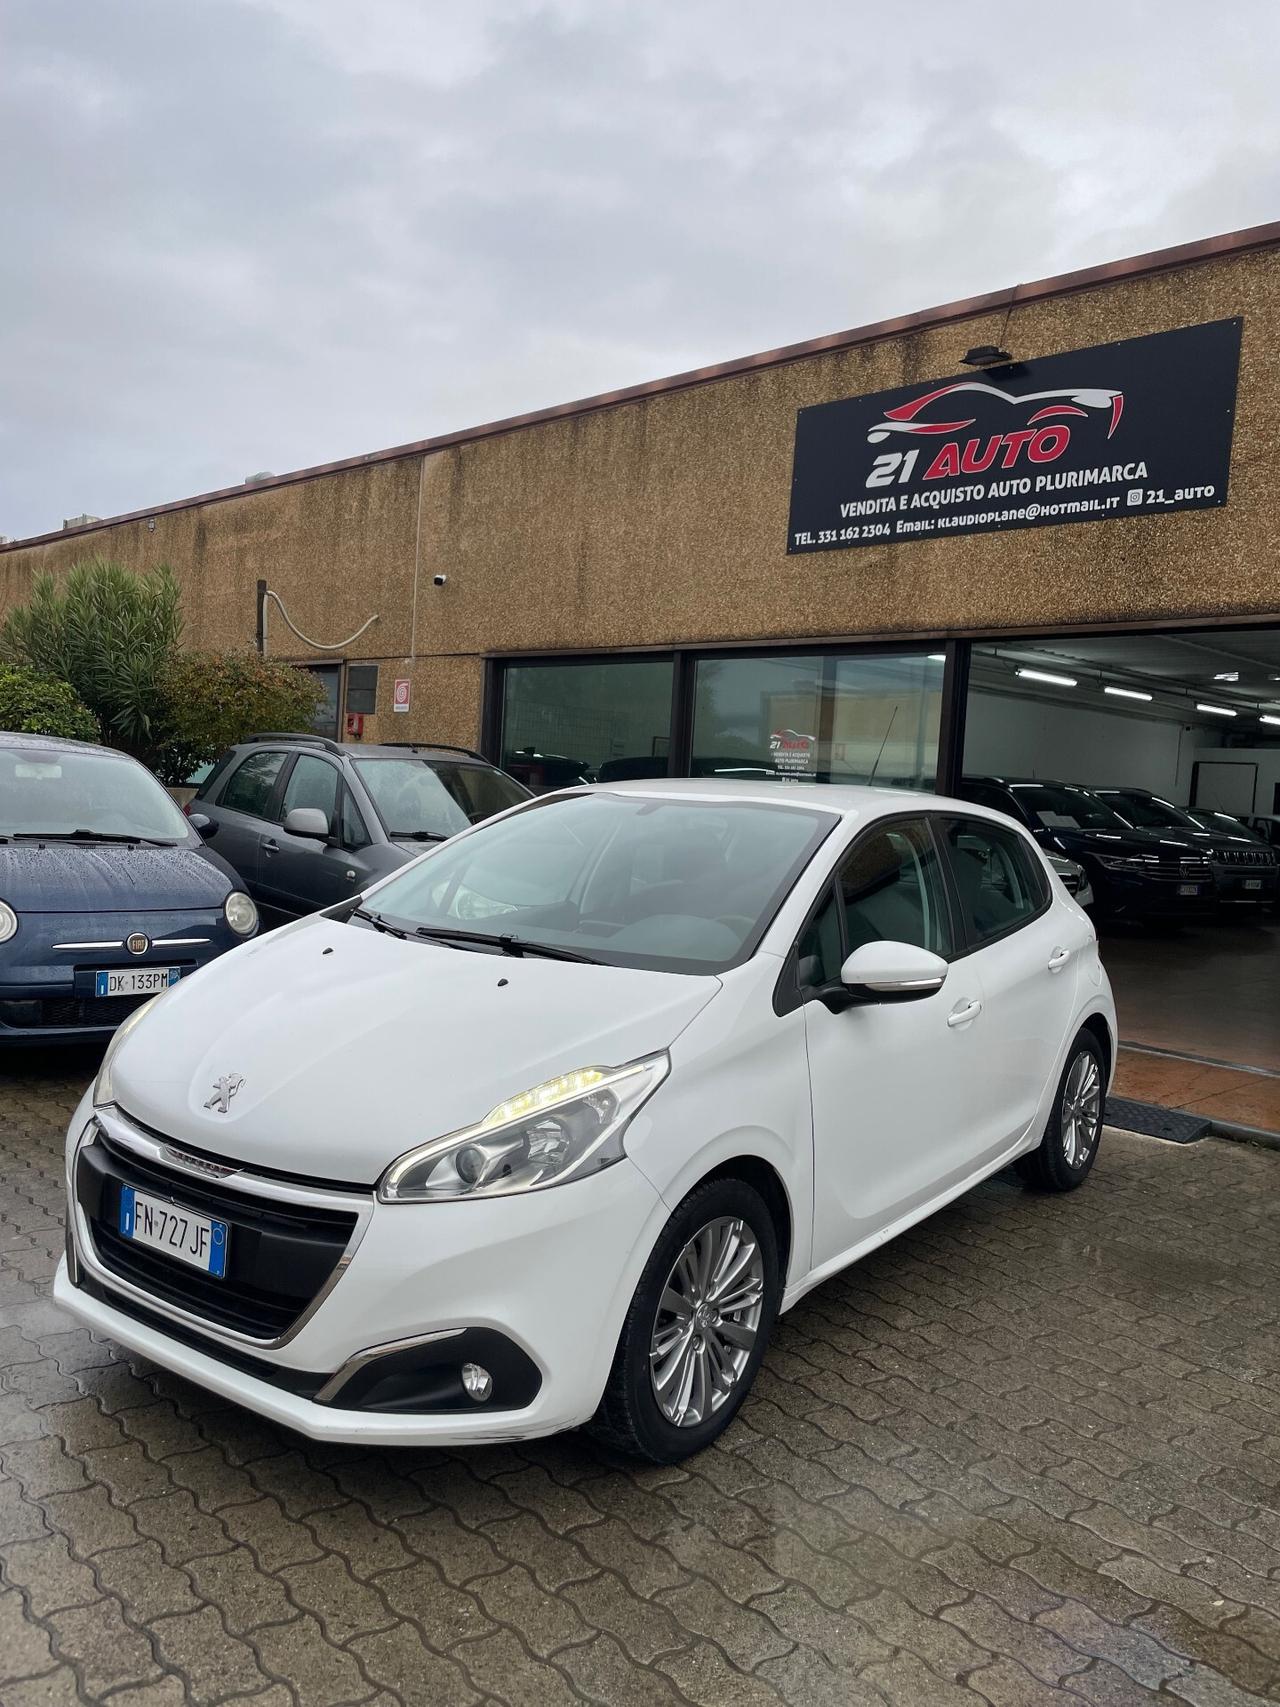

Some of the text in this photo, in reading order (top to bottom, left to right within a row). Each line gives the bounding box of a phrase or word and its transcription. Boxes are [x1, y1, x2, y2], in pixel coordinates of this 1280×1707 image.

[865, 425, 1070, 488] 21 AUTO
[840, 461, 1148, 518] VENDITA E ACQUISTO AUTO PLURIMARCA
[794, 532, 816, 546] TEL.
[817, 530, 837, 544] 331
[839, 527, 860, 541] 162
[861, 523, 891, 538] 2304
[770, 741, 780, 749] 21
[132, 939, 145, 950] FIAT
[109, 976, 124, 991] DK
[131, 973, 168, 990] 133PM
